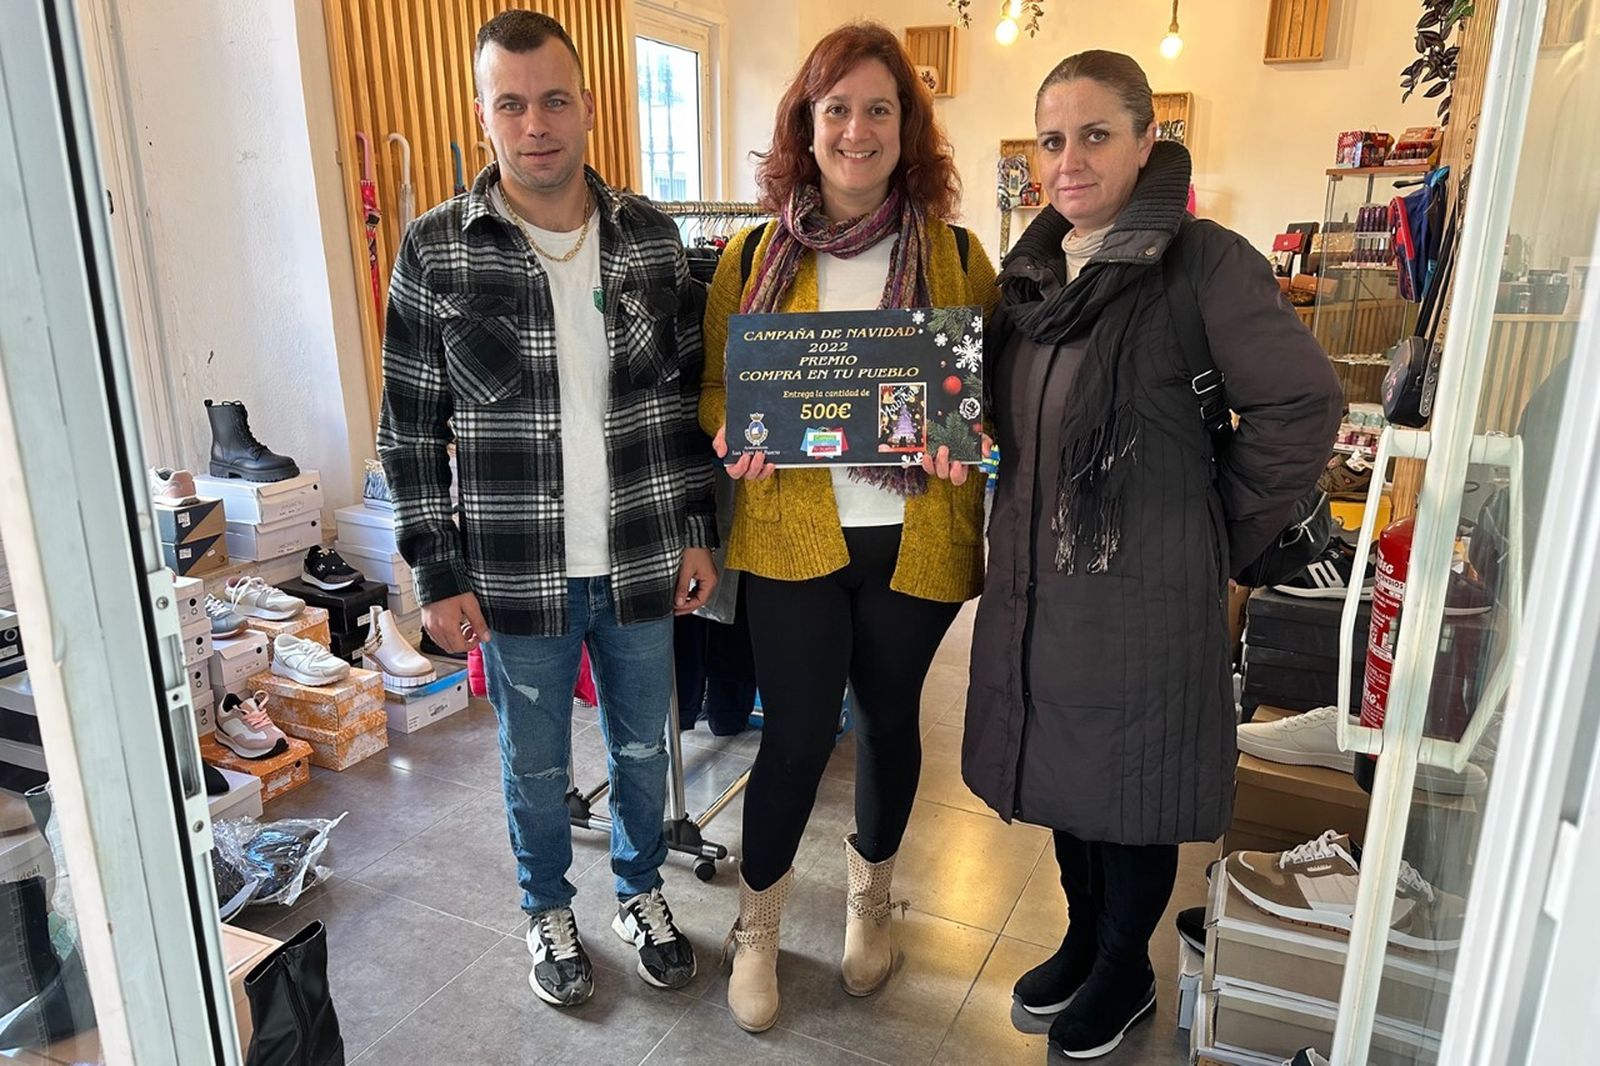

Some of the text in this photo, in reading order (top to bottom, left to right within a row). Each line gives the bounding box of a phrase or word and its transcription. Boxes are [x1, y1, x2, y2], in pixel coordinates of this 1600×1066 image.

[743, 327, 916, 341] CAMPAÑA DE NAVIDAD
[808, 342, 849, 353] 2022
[799, 355, 858, 366] PREMIO
[739, 367, 919, 381] COMPRA EN TU PUEBLO
[783, 389, 870, 400] Entrega la cantidad de
[800, 402, 852, 420] 500€
